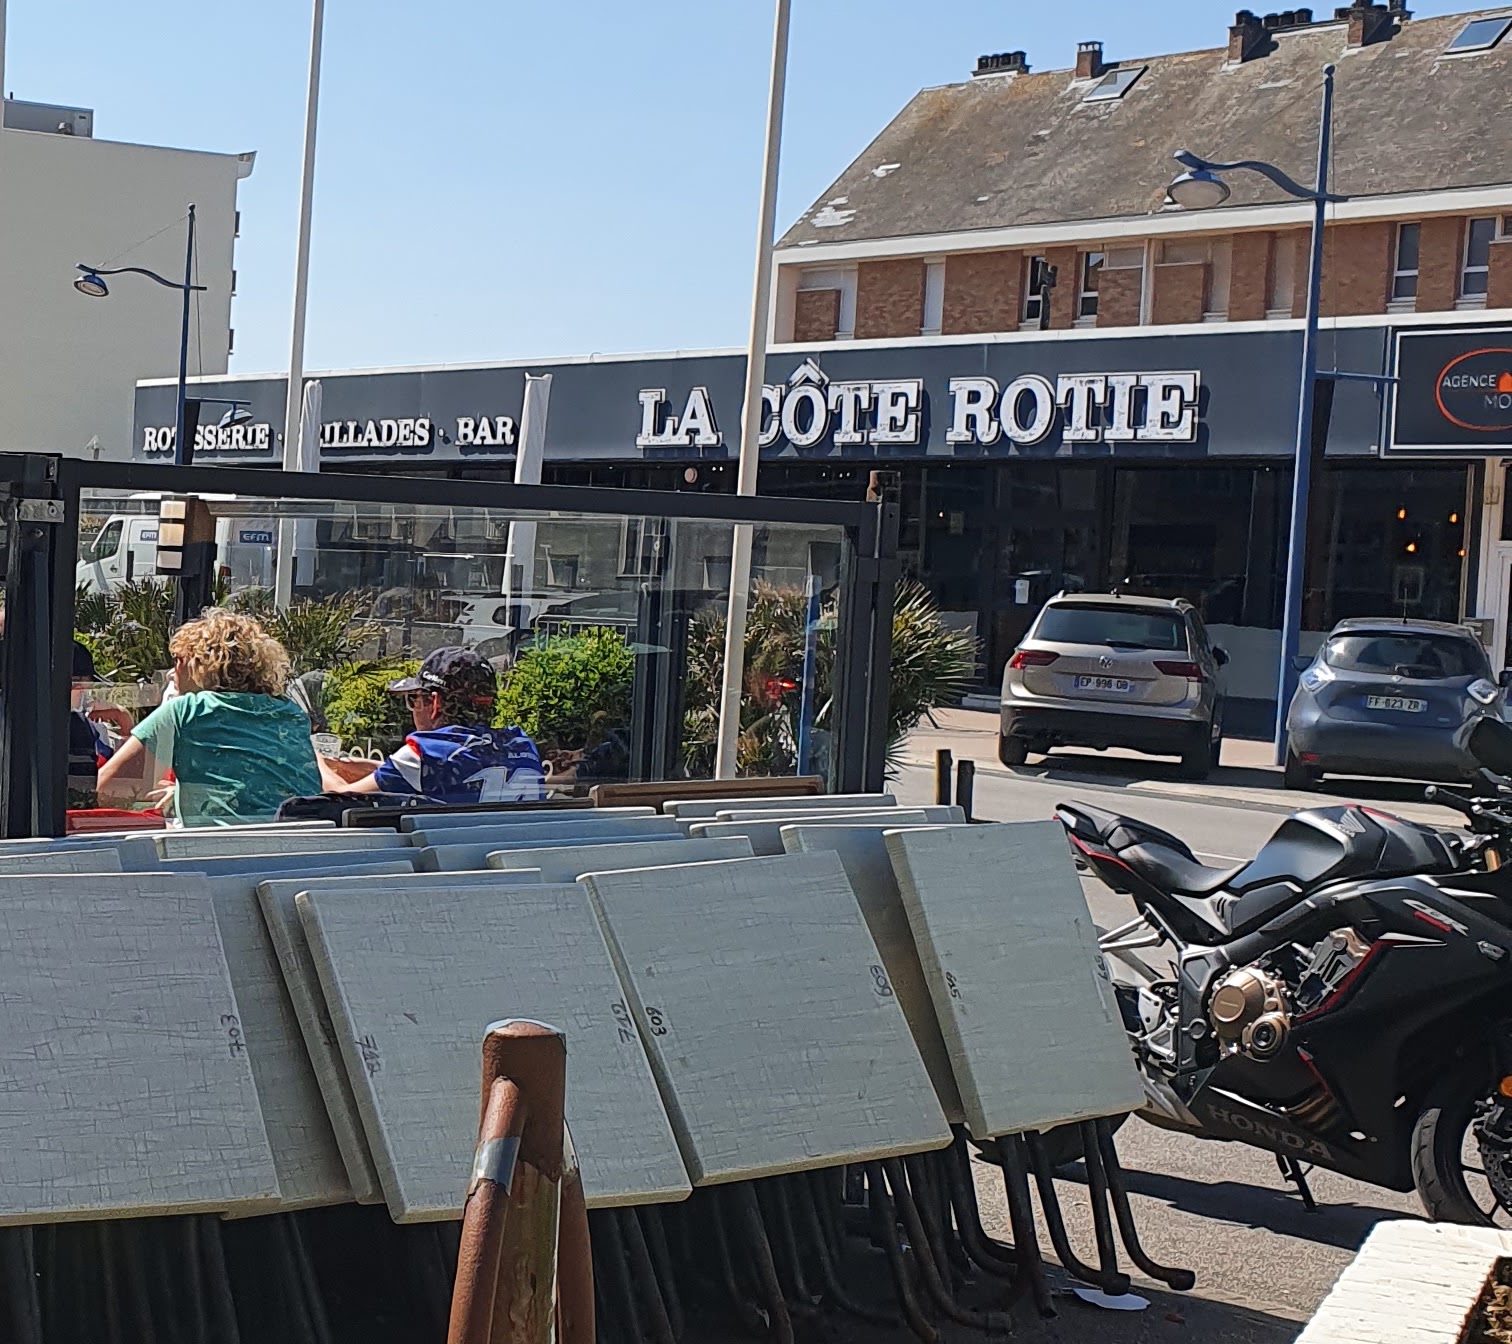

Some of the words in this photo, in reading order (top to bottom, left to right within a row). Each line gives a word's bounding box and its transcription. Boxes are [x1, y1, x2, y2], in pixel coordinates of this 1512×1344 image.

[1442, 375, 1497, 388] AGENCE
[635, 386, 723, 447] LA
[945, 370, 1201, 447] ROTIE
[142, 422, 270, 452] ROSSERIE
[320, 418, 430, 448] ILLADES
[455, 416, 514, 447] BAR
[1208, 1104, 1335, 1162] HONDA
